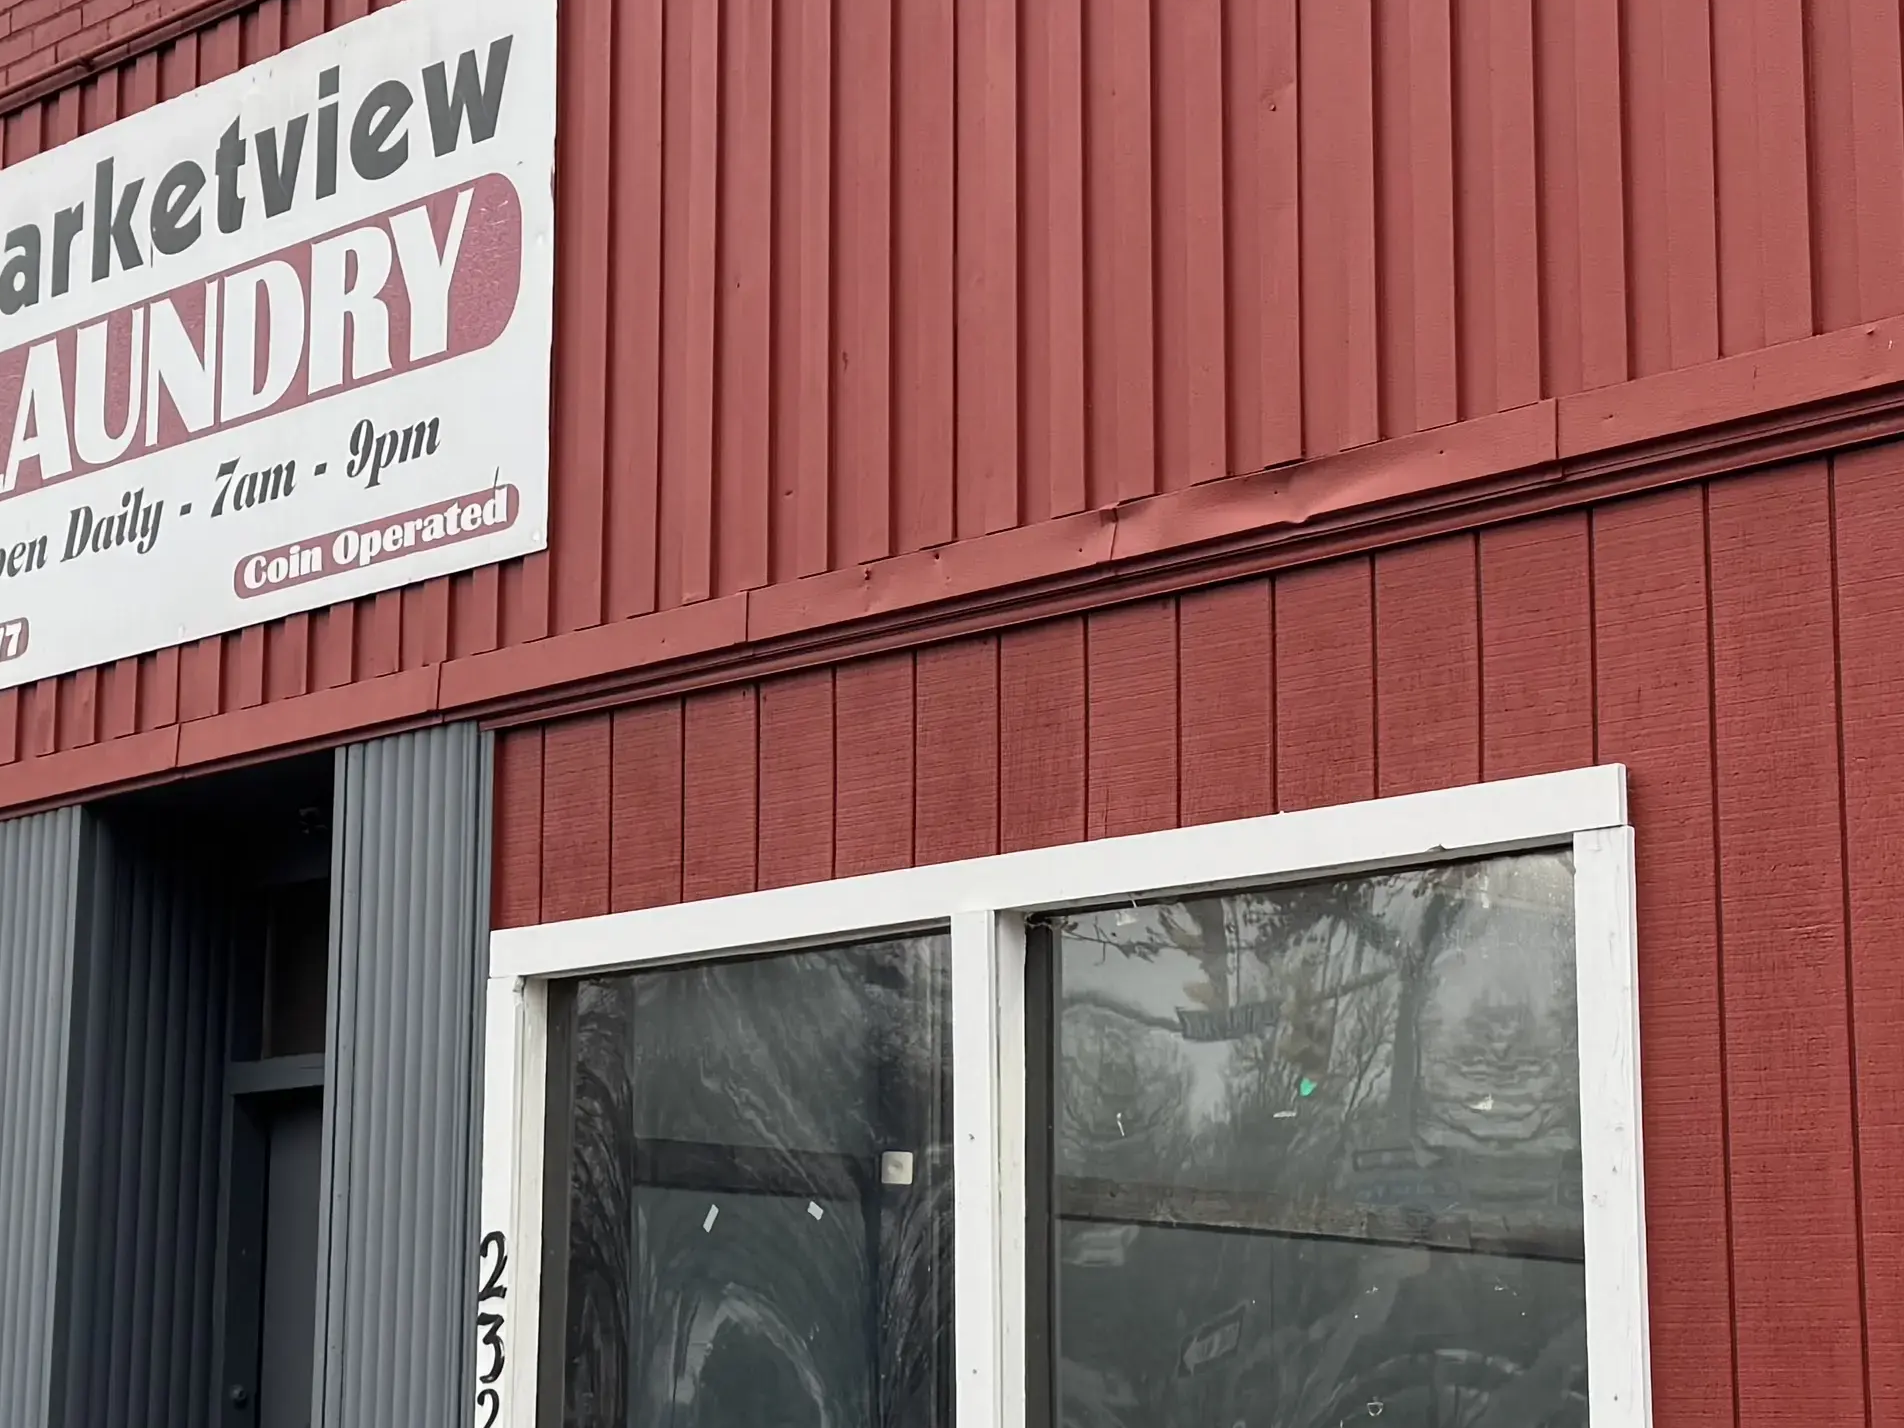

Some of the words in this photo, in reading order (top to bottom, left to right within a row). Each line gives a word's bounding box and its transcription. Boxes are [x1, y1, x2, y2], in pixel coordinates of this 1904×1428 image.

[59, 486, 165, 565] Daily
[210, 456, 298, 519] 7am
[347, 416, 442, 490] 9pm
[242, 544, 324, 591] Coin
[332, 485, 509, 567] Operated
